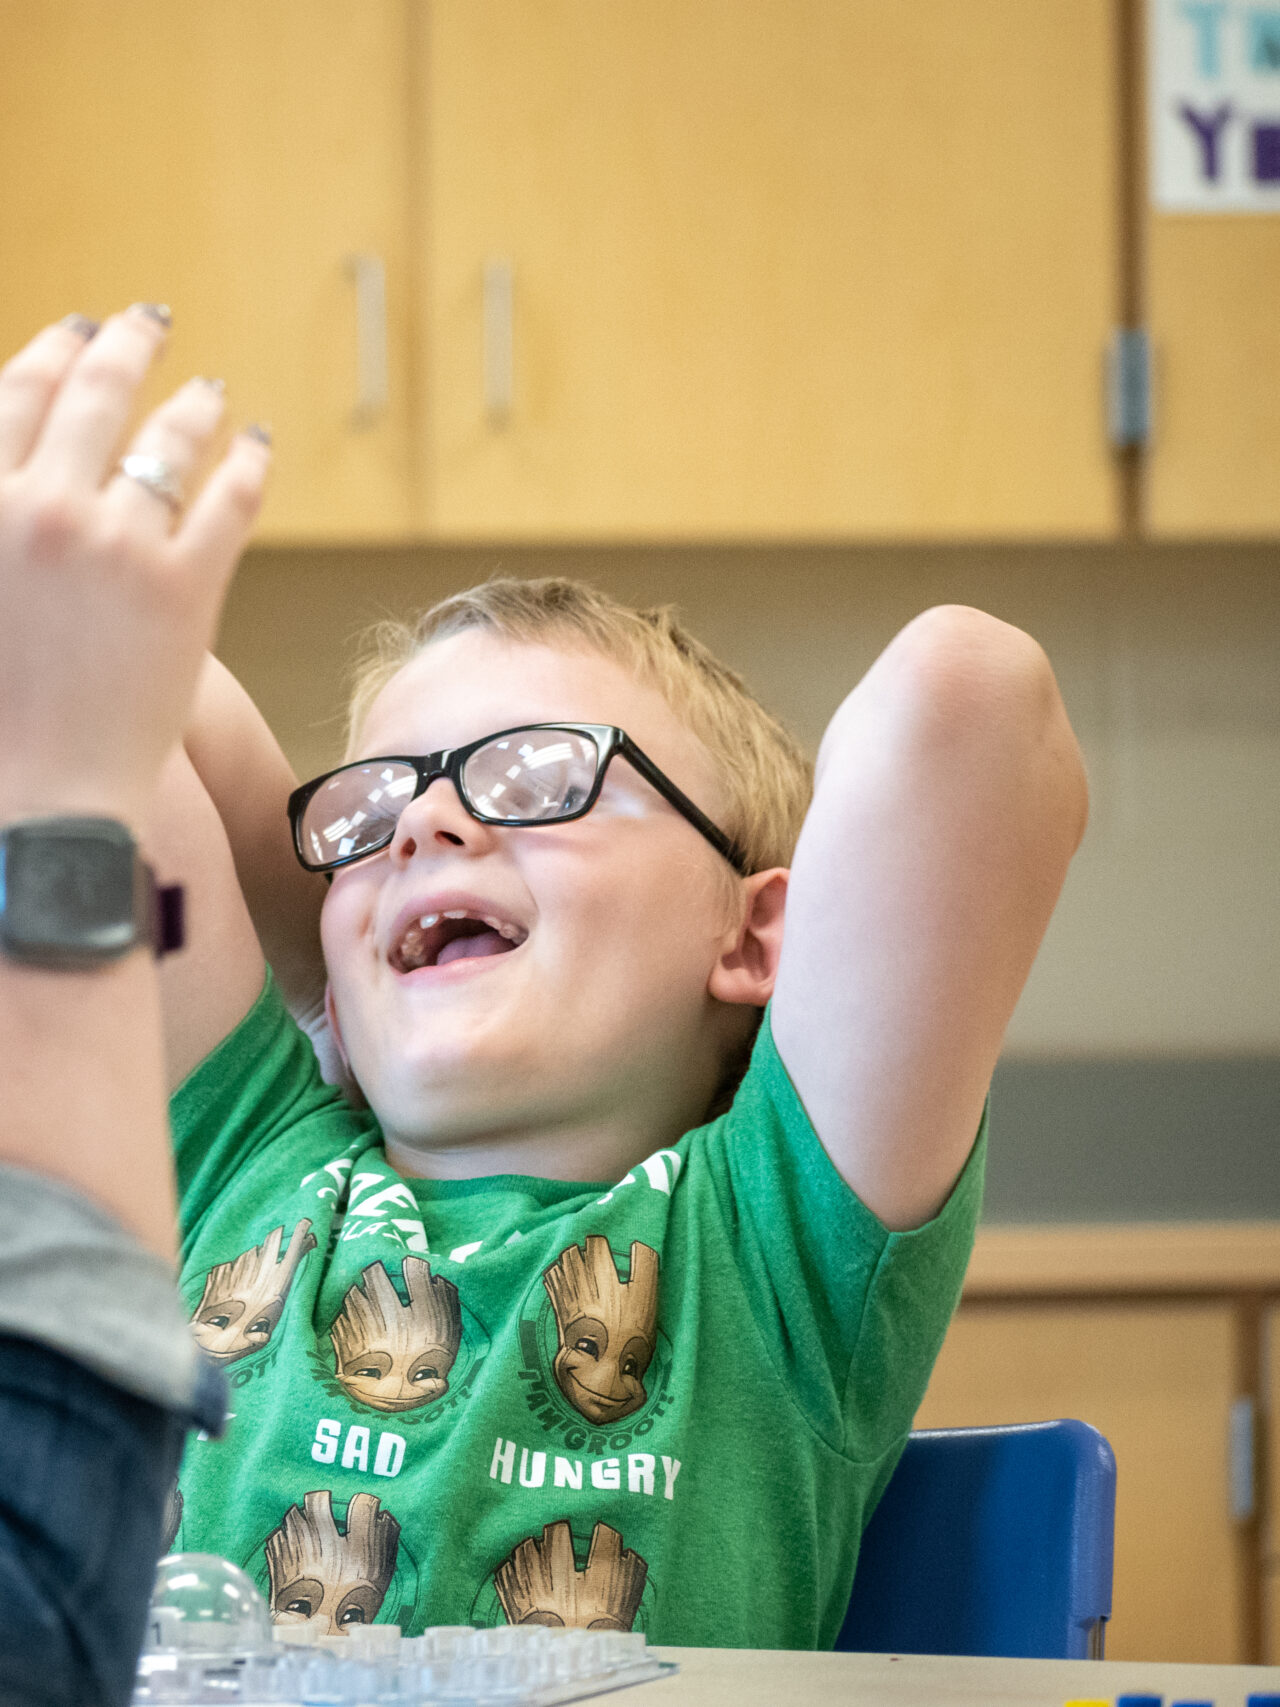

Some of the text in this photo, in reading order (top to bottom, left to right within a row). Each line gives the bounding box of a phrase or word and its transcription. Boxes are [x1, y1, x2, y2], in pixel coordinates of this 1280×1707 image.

[311, 1418, 407, 1478] SAD
[564, 1390, 675, 1456] GROOT!
[489, 1436, 682, 1501] HUNGRY
